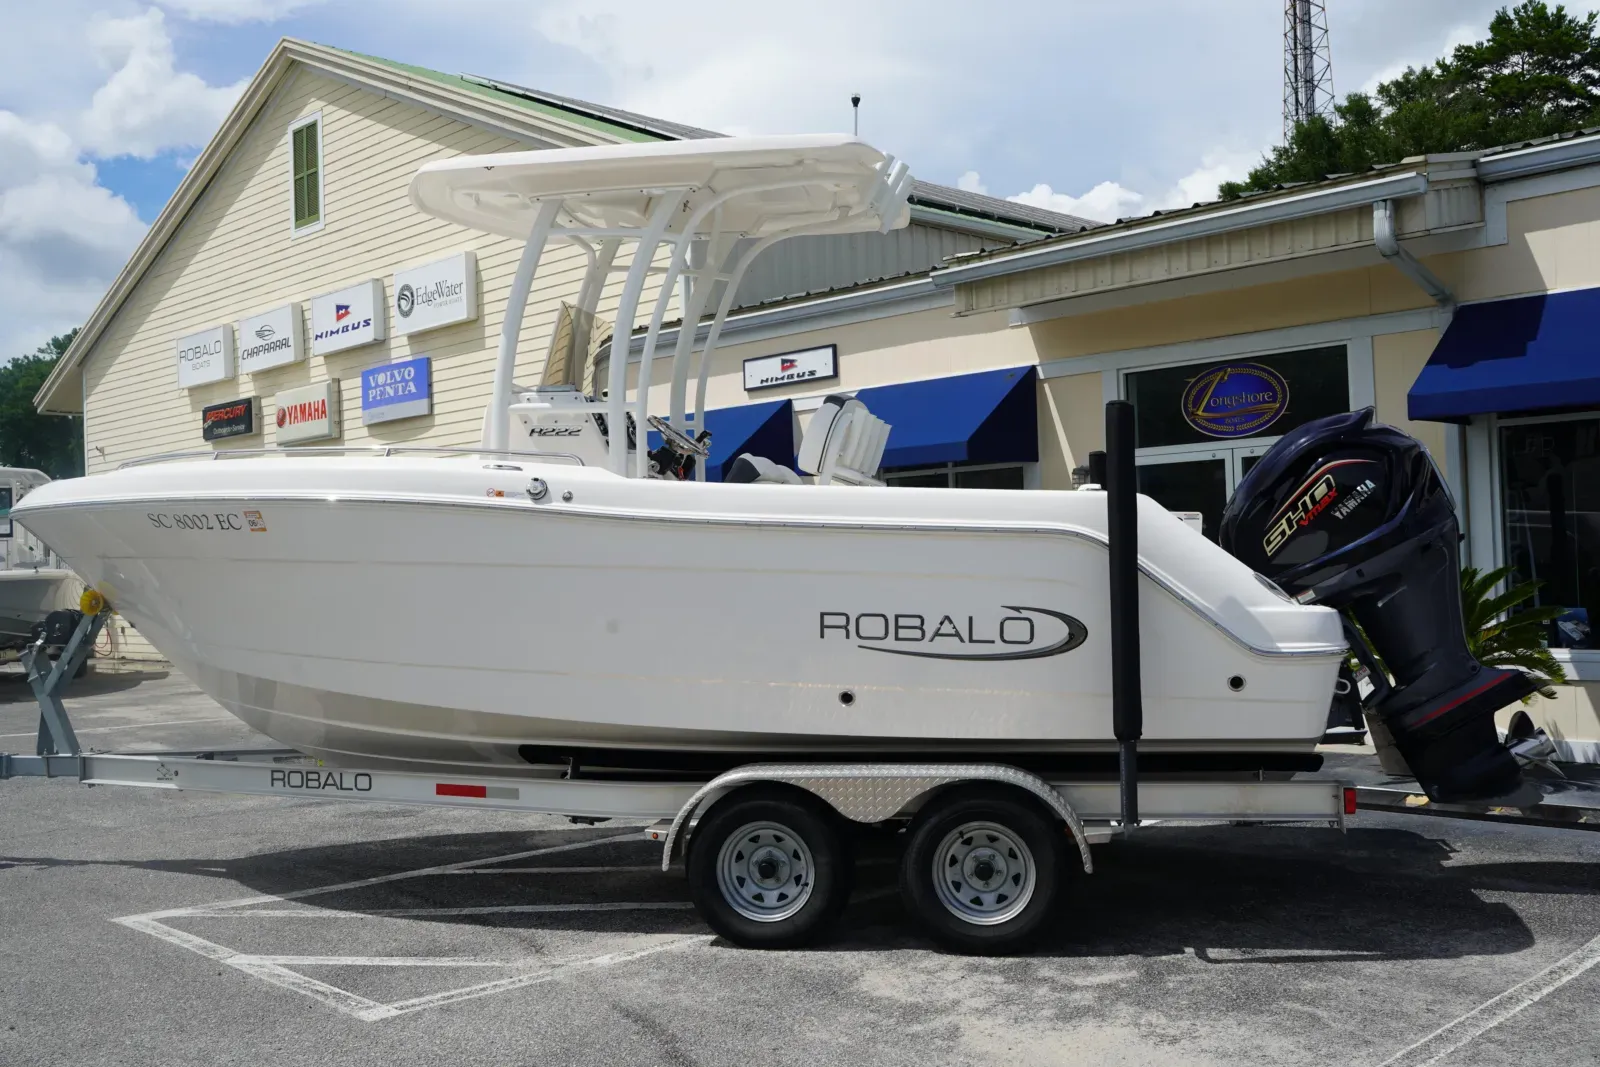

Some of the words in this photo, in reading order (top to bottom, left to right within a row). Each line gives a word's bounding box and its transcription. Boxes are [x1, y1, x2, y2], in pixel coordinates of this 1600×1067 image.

[415, 279, 463, 306] EdgeWater
[314, 318, 372, 341] NIMBUS
[179, 340, 222, 363] ROBALO
[242, 337, 292, 360] CHAPARRAL
[191, 359, 211, 371] BOATS
[368, 366, 415, 388] VOLVO
[760, 369, 817, 385] NIMBUS
[368, 382, 417, 402] PENTA
[1190, 367, 1280, 419] Longshore
[205, 404, 247, 422] MERCURY
[287, 399, 328, 425] YAMAHA
[1331, 479, 1376, 520] YAMAHA
[147, 513, 172, 528] SC
[173, 513, 214, 530] 8002
[214, 513, 242, 531] EC
[1263, 474, 1336, 557] SHO
[819, 611, 1035, 645] ROBALO
[270, 769, 373, 792] ROBALO
